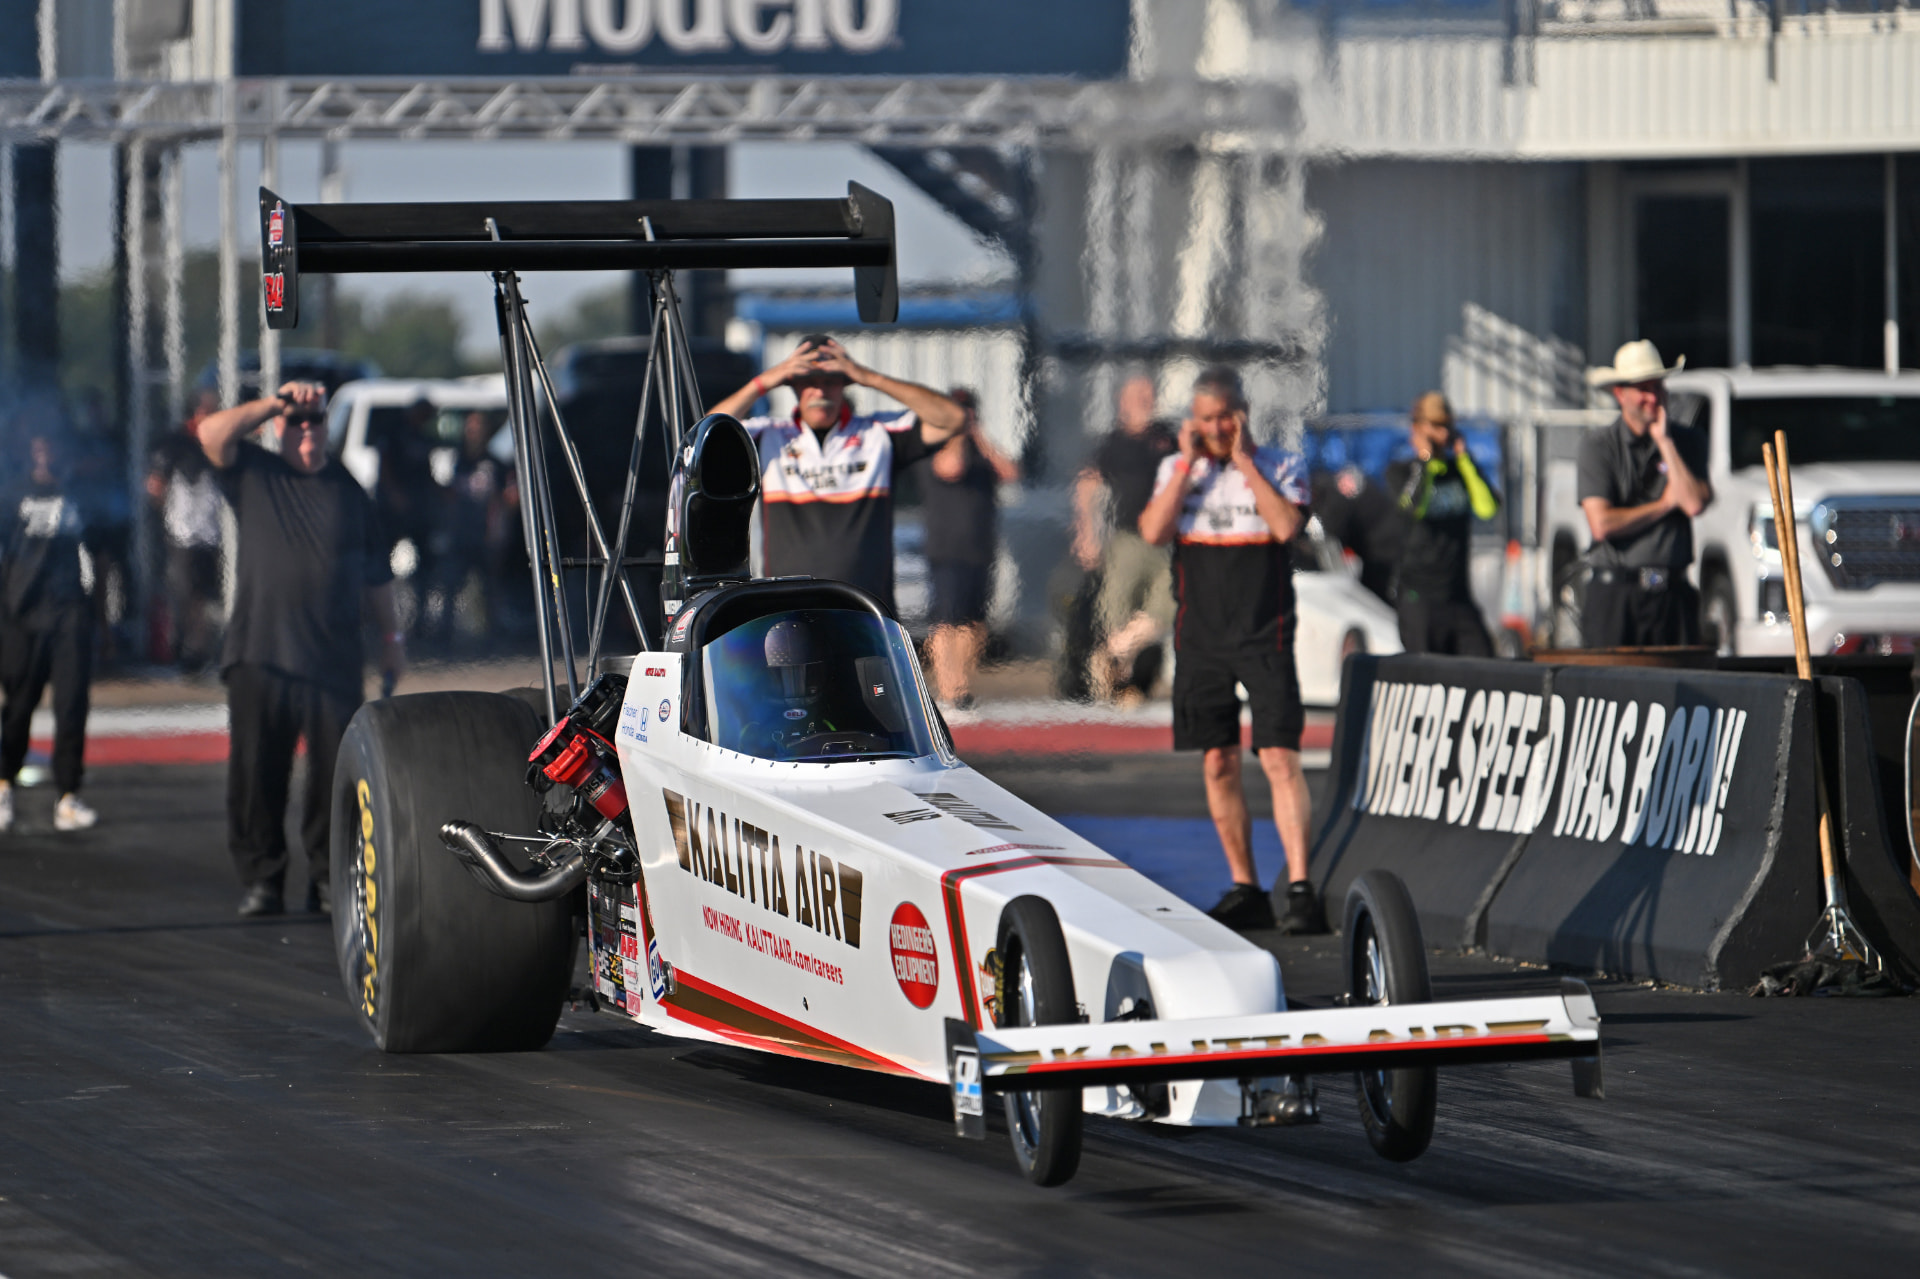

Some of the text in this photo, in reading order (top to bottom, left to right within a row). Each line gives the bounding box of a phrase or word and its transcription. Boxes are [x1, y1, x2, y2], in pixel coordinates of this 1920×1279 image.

[584, 773, 605, 796] MSD
[1353, 680, 1467, 821] WHERE
[1446, 689, 1566, 834] SPEED
[1553, 696, 1638, 842] WAS
[687, 798, 842, 942] KALITTA AIR
[702, 904, 844, 985] NOW HIRING KALITTAAIR.com/careers
[894, 954, 937, 986] EQUIPMENT
